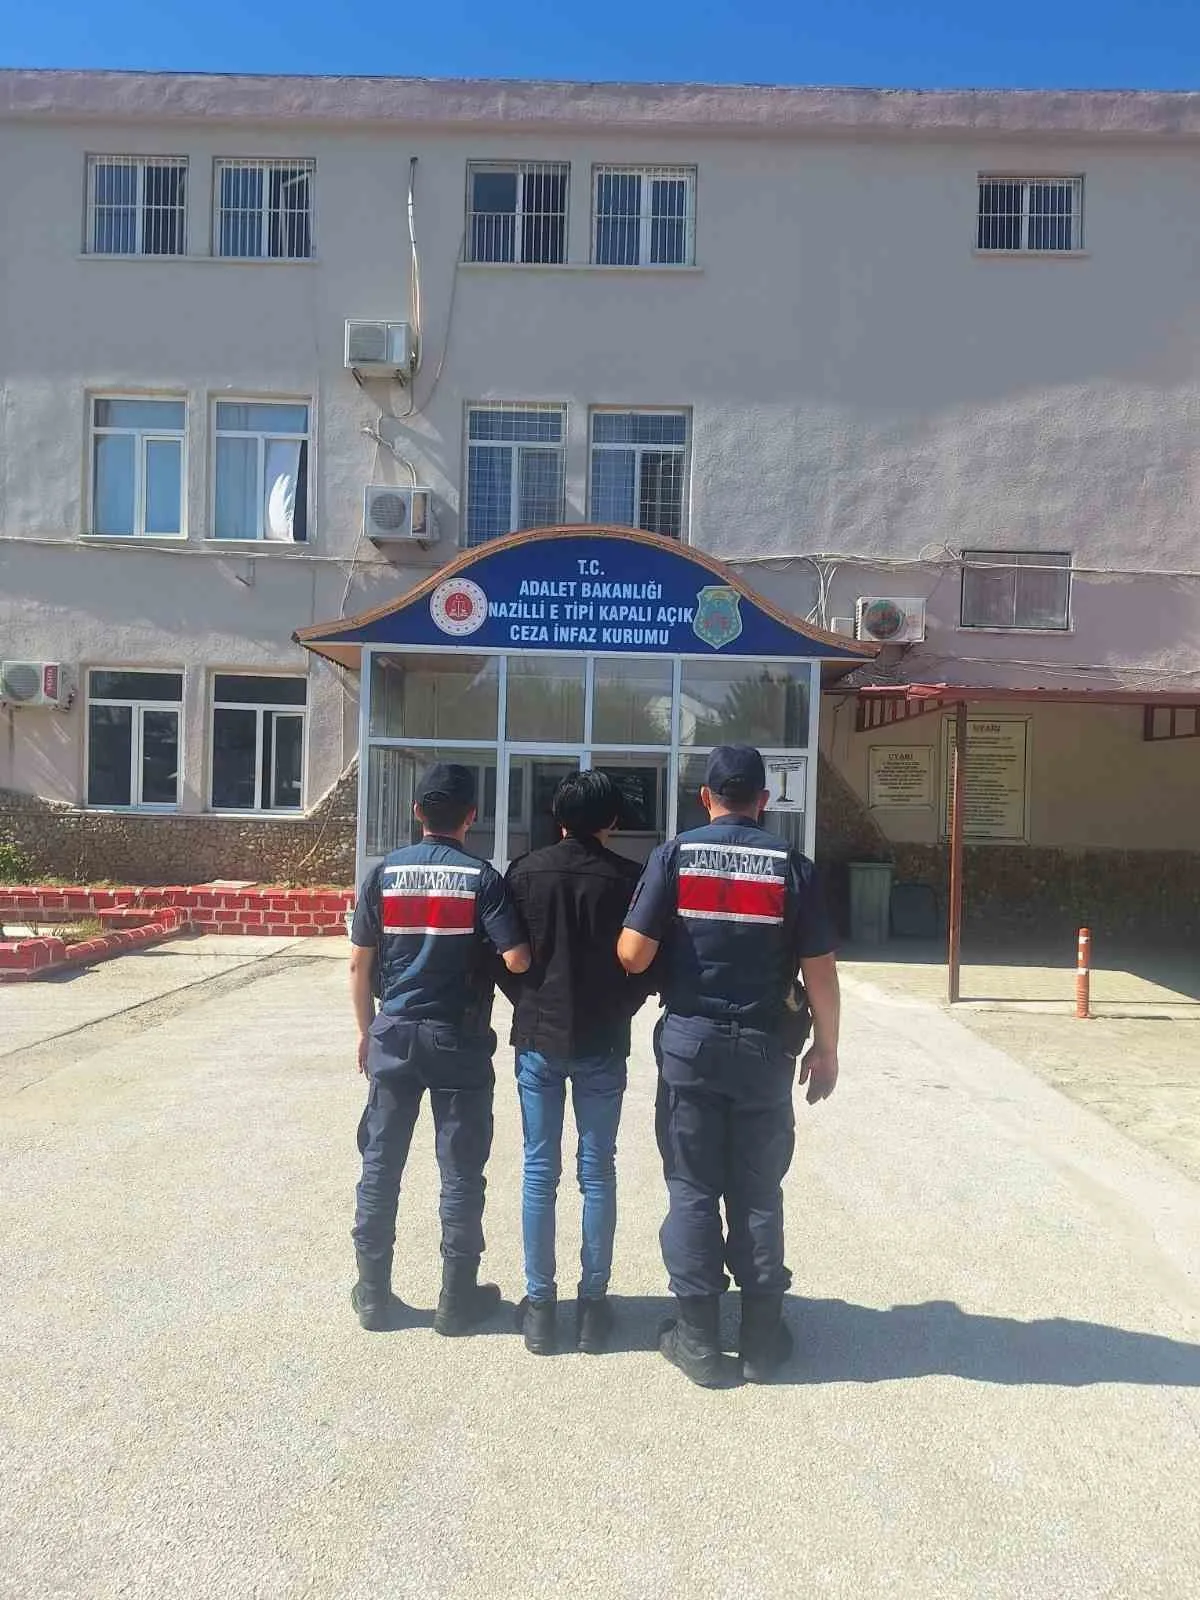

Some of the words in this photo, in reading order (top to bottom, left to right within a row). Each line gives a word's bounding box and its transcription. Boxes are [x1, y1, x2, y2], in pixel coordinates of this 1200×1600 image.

[577, 559, 605, 576] T.C.
[519, 580, 577, 598] ADALET
[581, 580, 662, 600] BAKANLIĞI
[488, 602, 545, 620] NAZİLLİ
[550, 603, 559, 620] E
[564, 602, 594, 621] TİPİ
[599, 604, 652, 622] KAPALI
[656, 606, 694, 627] AÇIK
[510, 624, 549, 643] CEZA
[554, 623, 597, 644] İNFAZ
[602, 627, 669, 645] KURUMU
[689, 849, 775, 876] JANDARMA
[391, 870, 468, 891] JANDARMA
